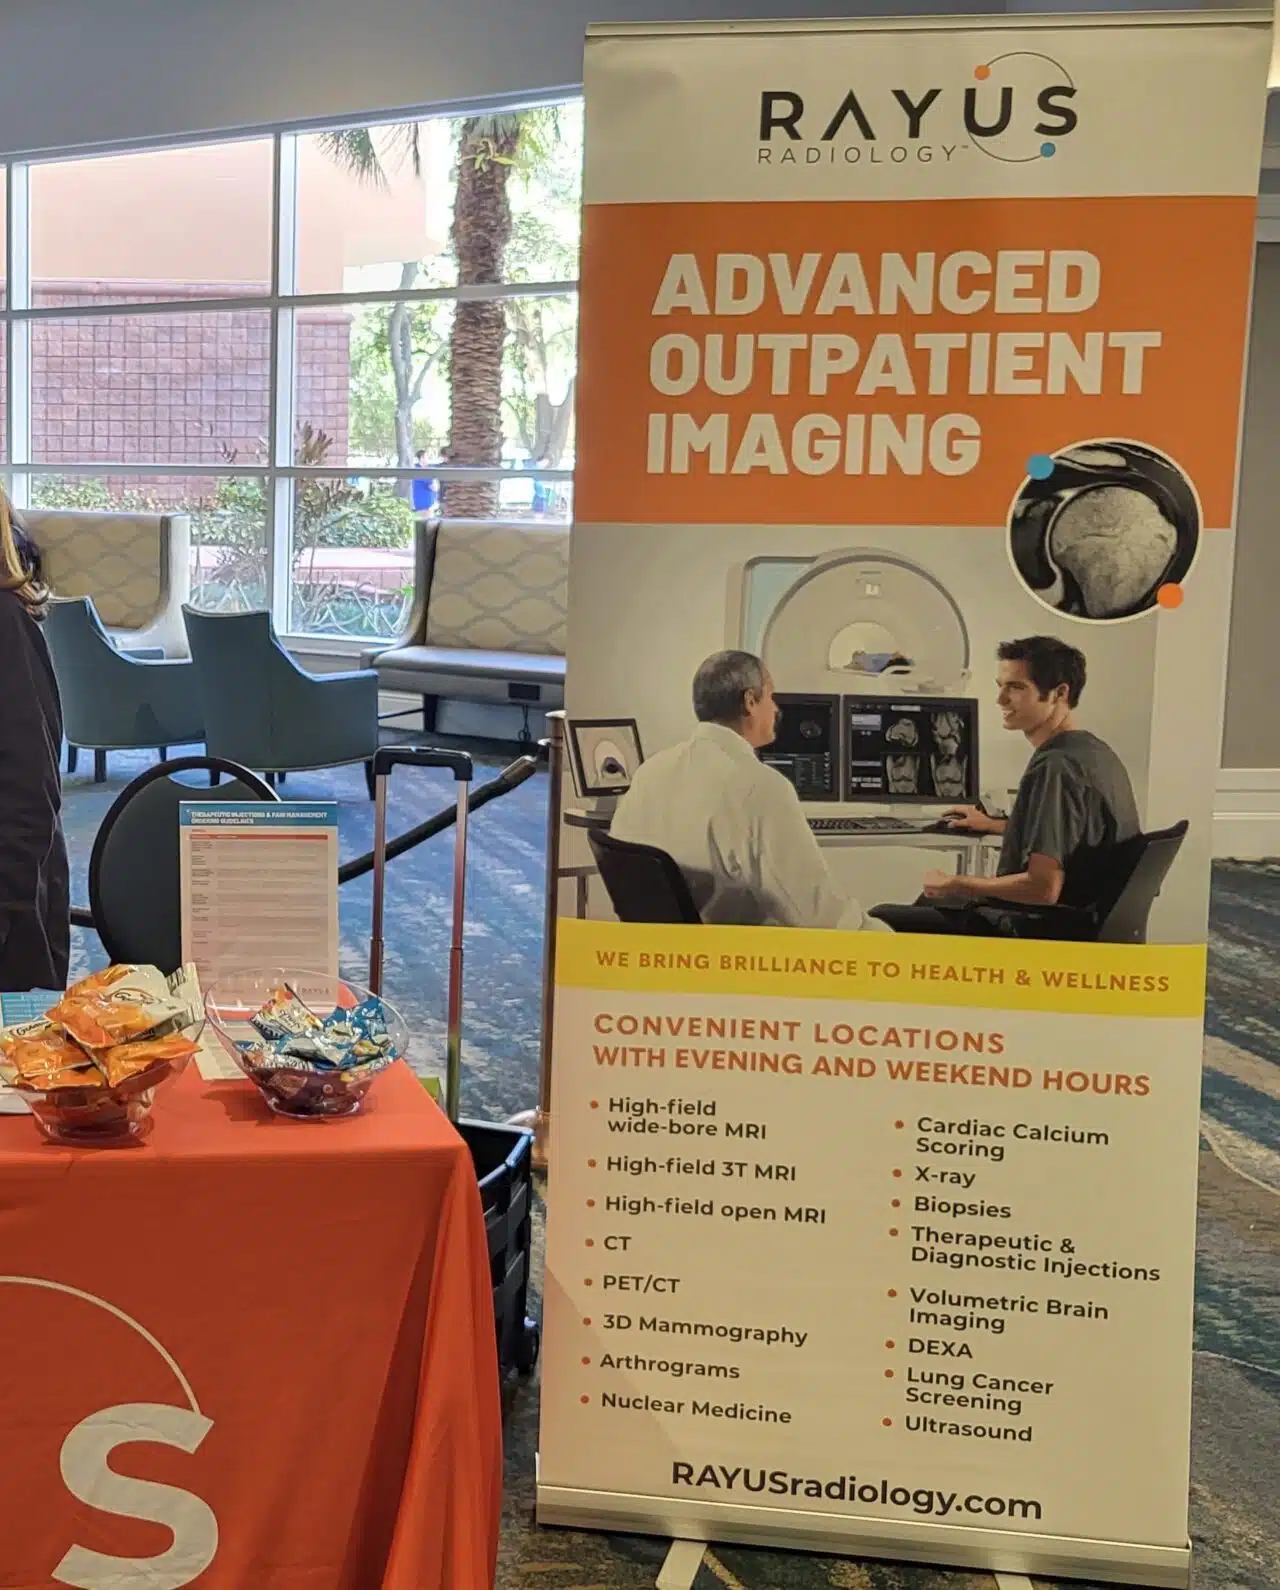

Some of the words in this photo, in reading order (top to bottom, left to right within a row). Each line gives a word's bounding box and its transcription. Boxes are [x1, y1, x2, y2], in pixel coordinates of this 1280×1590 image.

[758, 87, 1078, 140] RAYUS
[757, 145, 956, 164] RADIOLOGY
[652, 250, 1100, 315] ADVANCED
[650, 332, 1161, 395] OUTPATIENT
[648, 413, 980, 475] IMAGING
[596, 951, 628, 967] WE
[640, 953, 709, 969] BRING
[720, 955, 856, 976] BRILLIANCE
[867, 962, 900, 978] TO
[912, 964, 1004, 984] HEALTH
[1015, 970, 1030, 985] &
[1042, 971, 1168, 992] WELLNESS
[594, 1014, 800, 1041] CONVENIENT
[815, 1024, 1003, 1054] LOCATIONS
[593, 1045, 665, 1067] WITH
[676, 1049, 802, 1074] EVENING
[812, 1056, 876, 1077] AND
[886, 1060, 1032, 1088] WEEKEND
[1043, 1070, 1149, 1096] HOURS
[609, 1097, 717, 1116] High-field
[608, 1119, 718, 1137] wide-bore
[726, 1123, 765, 1139] MRI
[917, 1117, 1005, 1137] Cardiac
[1013, 1124, 1108, 1145] Calcium
[917, 1138, 1005, 1162] Scoring
[608, 1156, 714, 1175] High-field
[722, 1162, 747, 1177] 3T
[755, 1164, 795, 1180] MRI
[916, 1166, 975, 1188] X-ray
[606, 1196, 713, 1215] High-field
[721, 1206, 776, 1221] open
[785, 1207, 825, 1223] MRI
[915, 1196, 1011, 1218] Biopsies
[604, 1236, 631, 1250] CT
[912, 1226, 1053, 1252] Therapeutic
[1060, 1239, 1075, 1253] &
[912, 1246, 1038, 1271] Diagnostic
[1044, 1258, 1159, 1280] Injections
[604, 1275, 680, 1293] PET/CT
[911, 1288, 1039, 1313] Volumetric
[1047, 1300, 1107, 1319] Brain
[604, 1315, 631, 1329] 3D
[640, 1317, 807, 1347] Mammography
[910, 1308, 1005, 1334] Imaging
[909, 1339, 972, 1358] DEXA
[600, 1354, 739, 1378] Arthrograms
[907, 1367, 965, 1390] Lung
[973, 1374, 1054, 1395] Cancer
[602, 1393, 684, 1413] Nuclear
[692, 1401, 791, 1423] Medicine
[906, 1387, 1022, 1415] Screening
[906, 1416, 1032, 1441] Ultrasound
[671, 1462, 1042, 1519] RAYUSradiology.com
